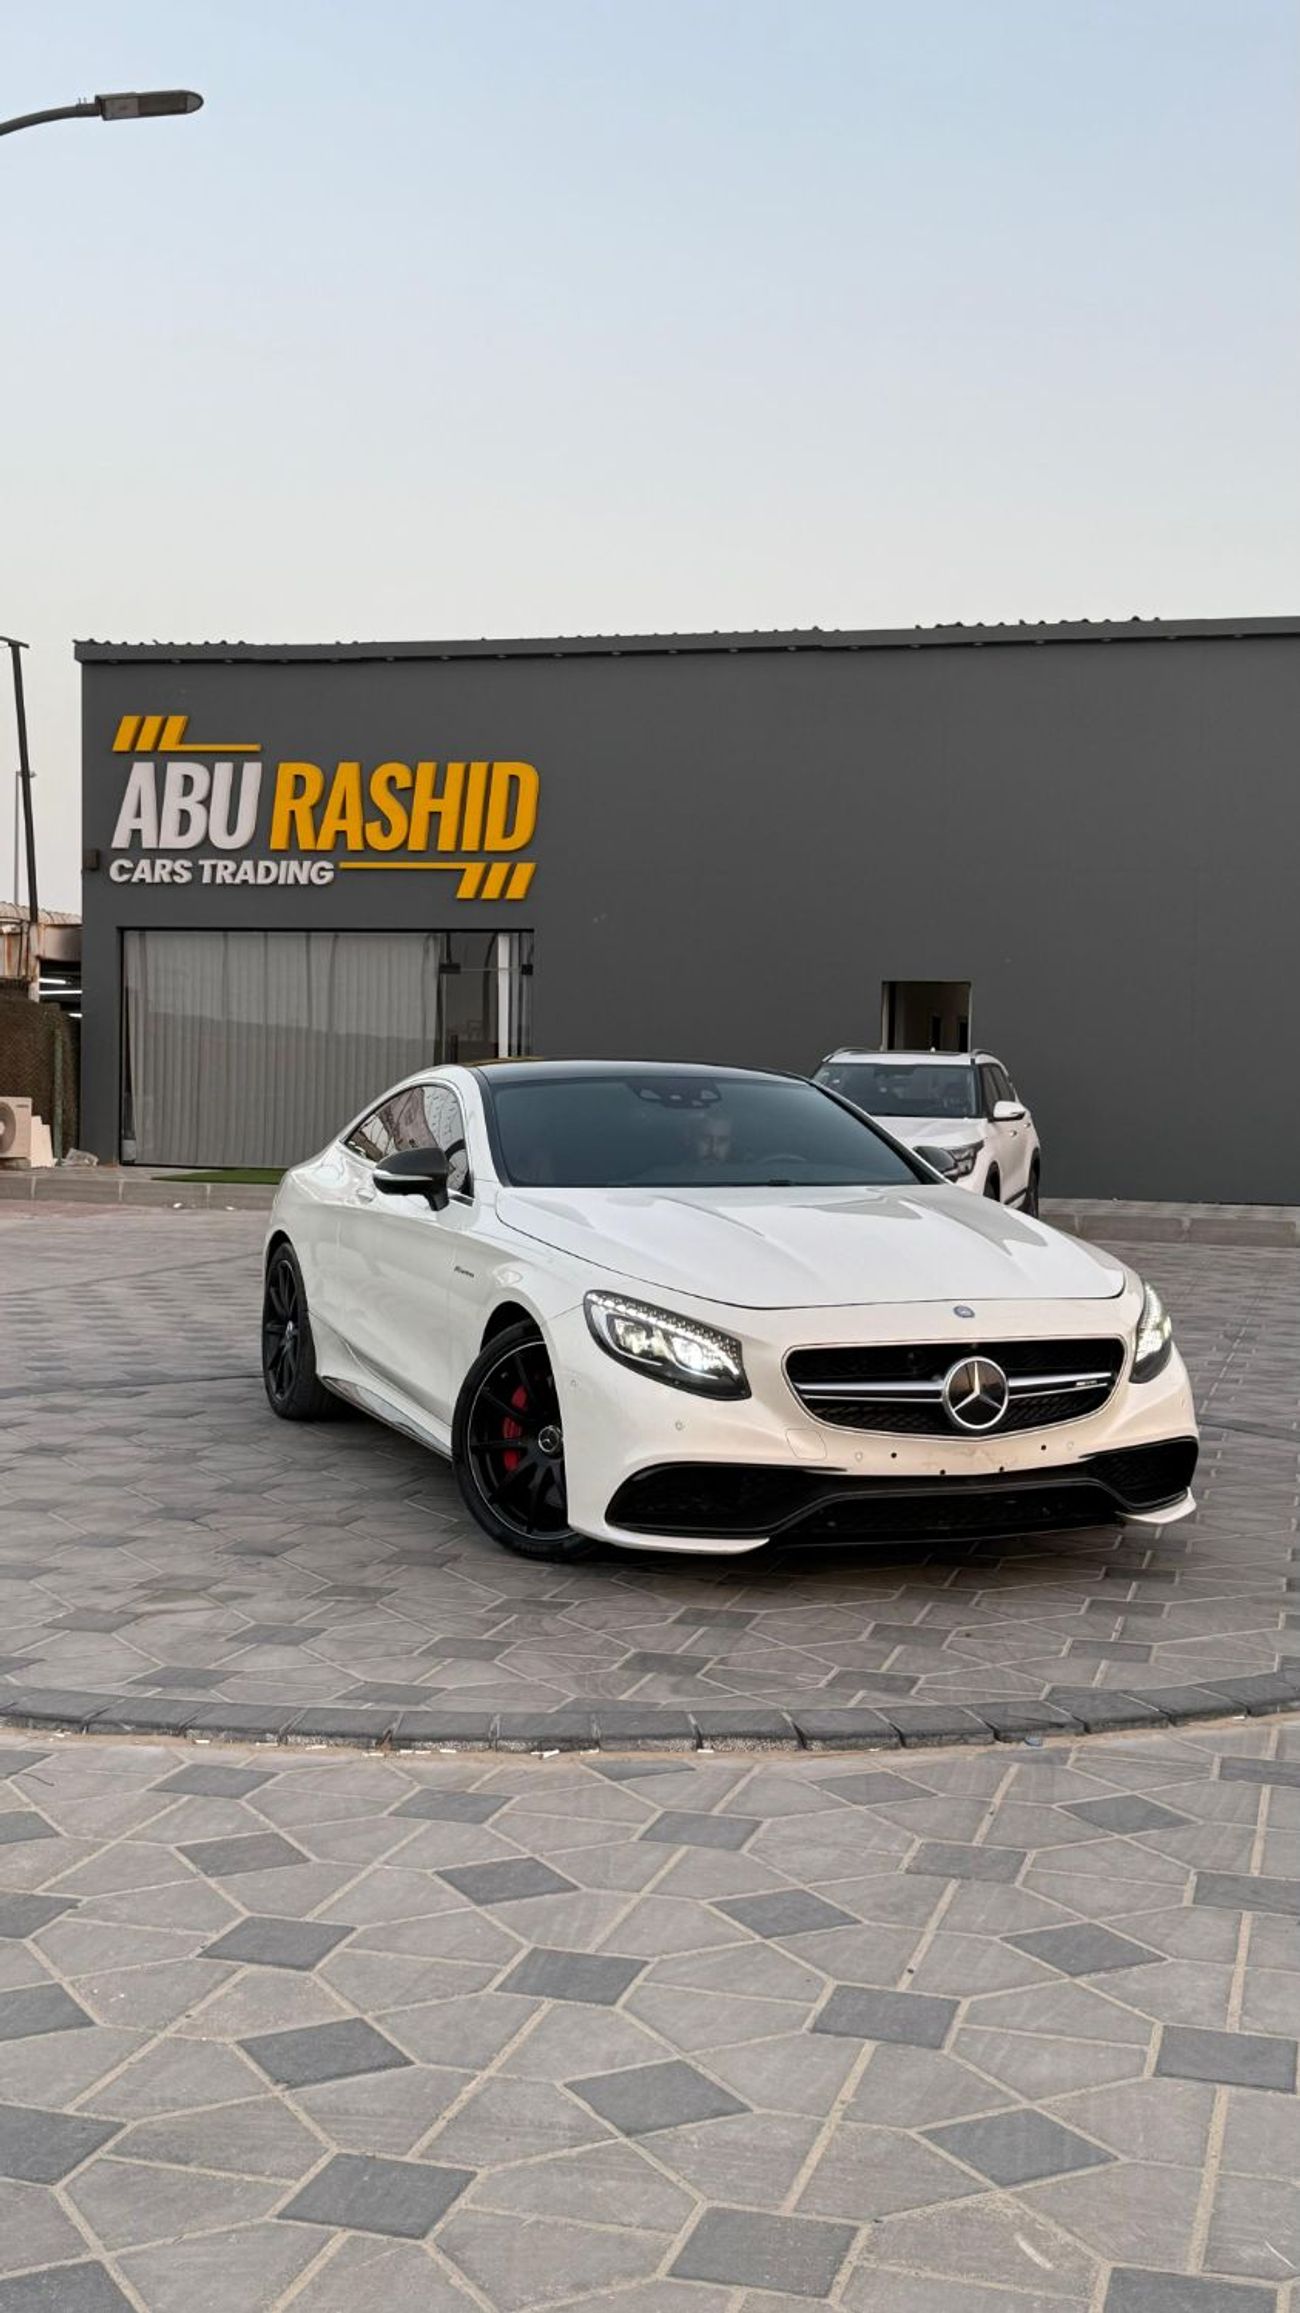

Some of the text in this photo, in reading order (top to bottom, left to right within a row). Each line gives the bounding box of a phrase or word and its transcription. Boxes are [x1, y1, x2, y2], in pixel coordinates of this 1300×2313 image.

[111, 762, 539, 851] ABU RASHID
[109, 859, 335, 886] CARS TRADING
